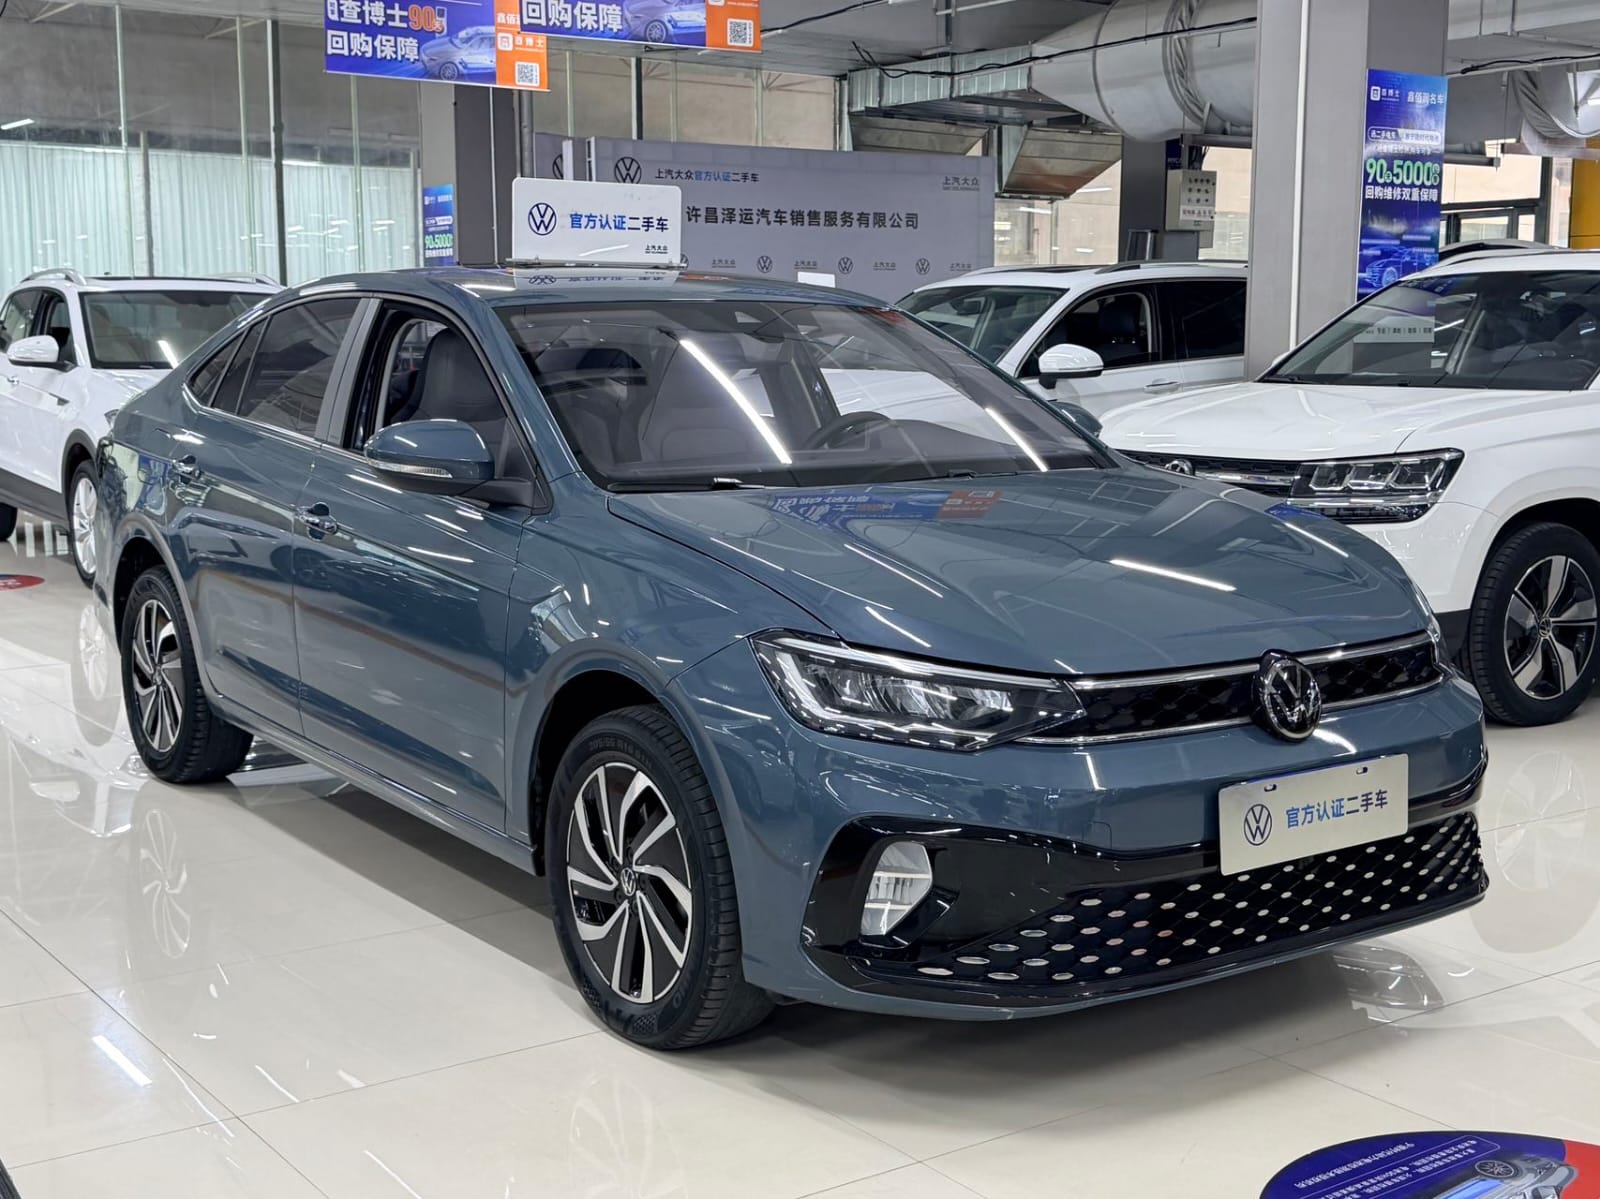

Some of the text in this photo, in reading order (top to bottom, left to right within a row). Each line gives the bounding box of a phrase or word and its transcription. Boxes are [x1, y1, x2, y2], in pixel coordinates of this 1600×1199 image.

[521, 0, 623, 32] 回购保障
[327, 29, 419, 62] 回购保障
[655, 168, 760, 183] 上汽大众官方认证二手车
[570, 213, 669, 232] 官方认证二手车
[686, 206, 919, 229] 许昌泽运汽车销售服务有限公司
[1286, 788, 1388, 829] 官方认证二手车
